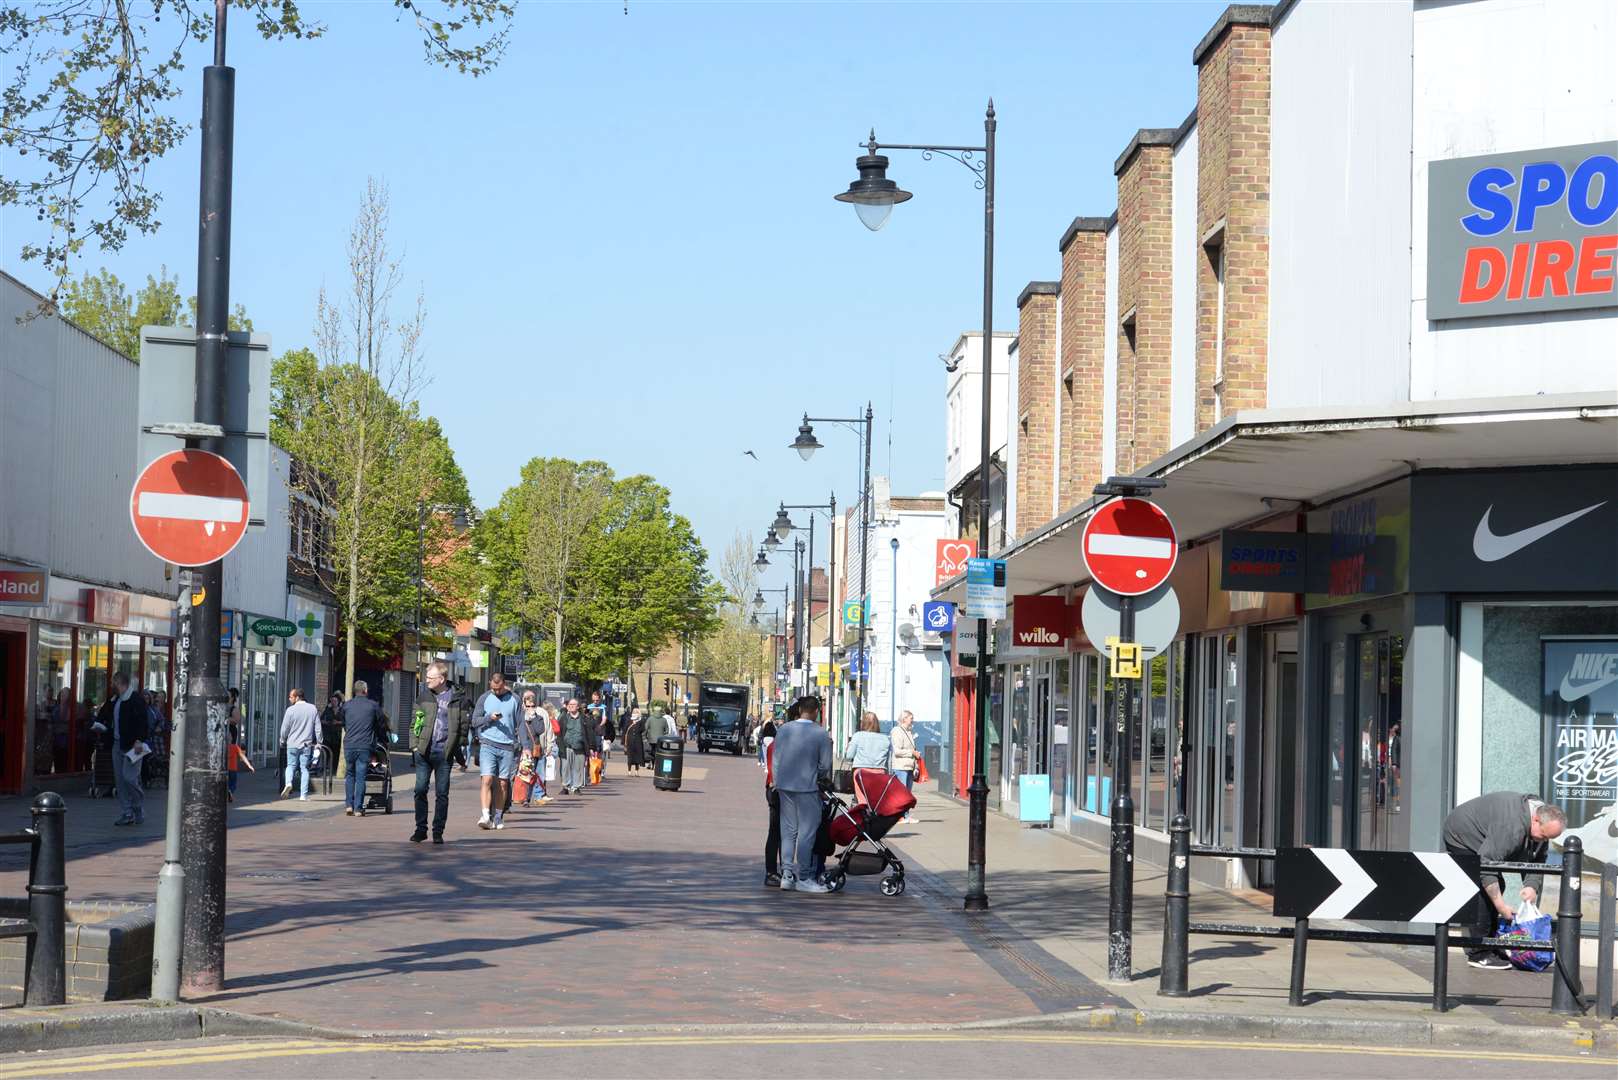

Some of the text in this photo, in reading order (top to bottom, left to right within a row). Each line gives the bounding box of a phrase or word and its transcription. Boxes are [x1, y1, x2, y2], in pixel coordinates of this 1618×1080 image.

[1459, 154, 1618, 238] SPO
[1458, 233, 1618, 304] DIRE
[1019, 626, 1060, 643] wilko
[1569, 653, 1618, 680] NIKE
[1557, 729, 1587, 748] AIR
[1571, 789, 1610, 797] SPORTSWEAR
